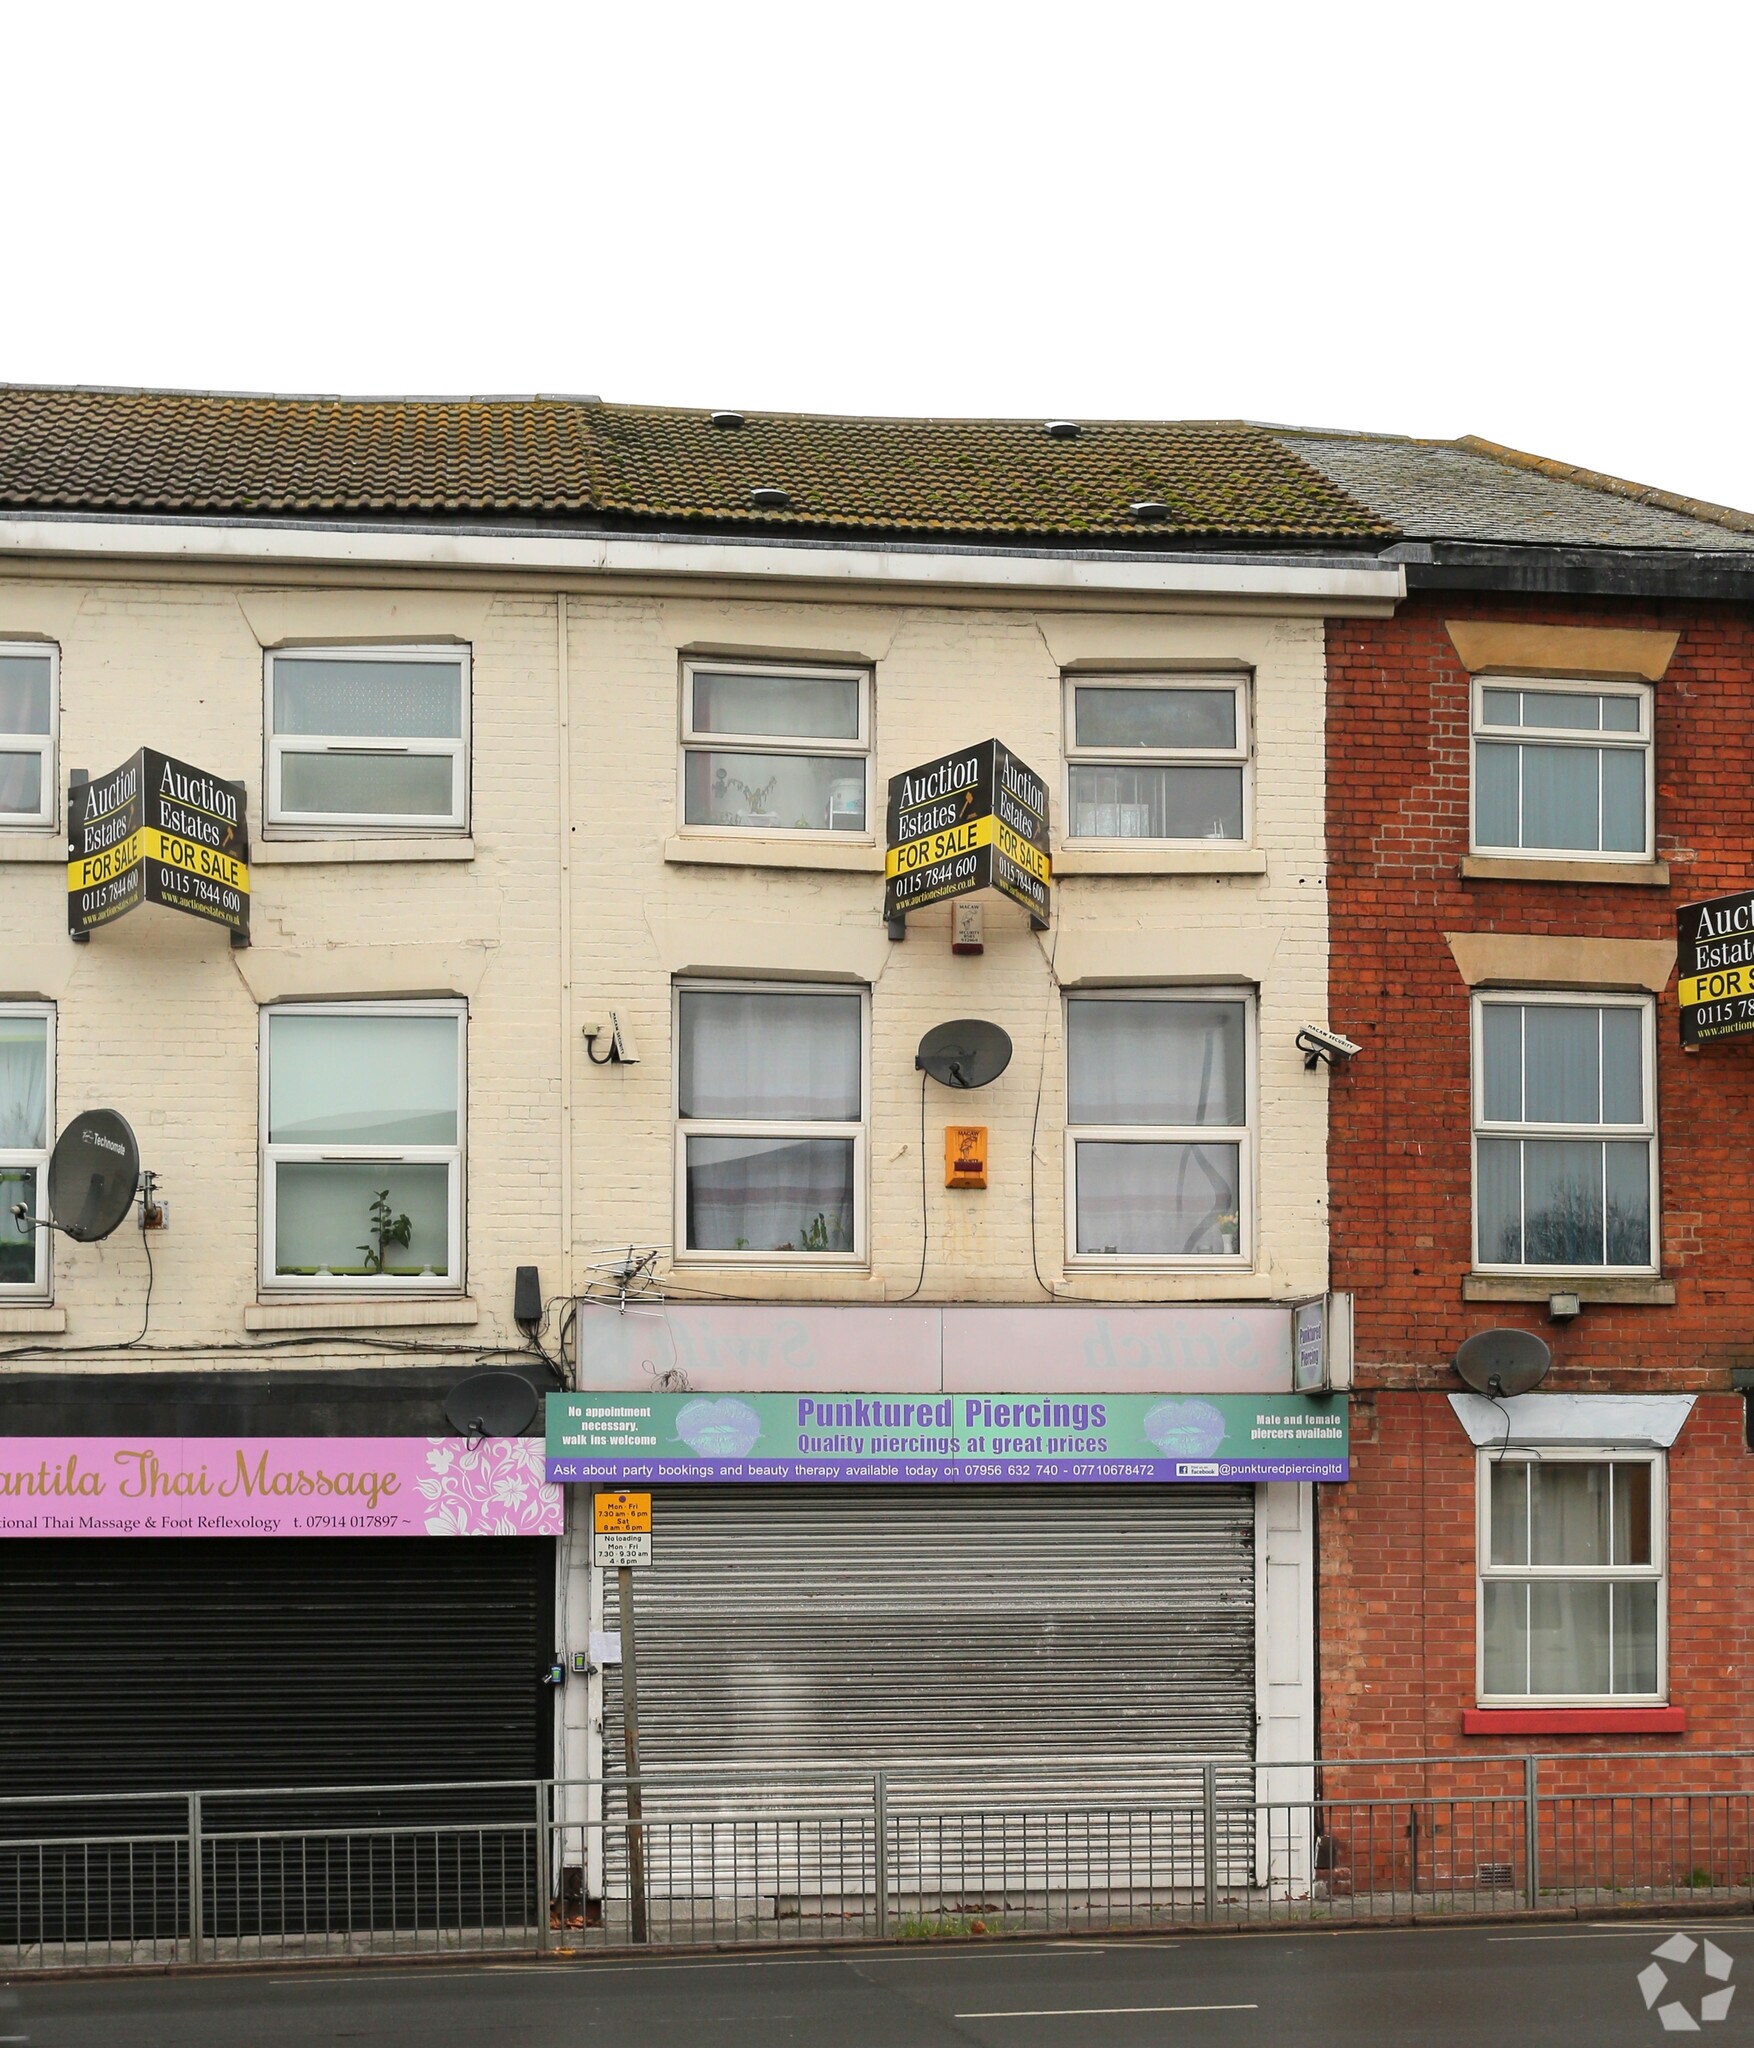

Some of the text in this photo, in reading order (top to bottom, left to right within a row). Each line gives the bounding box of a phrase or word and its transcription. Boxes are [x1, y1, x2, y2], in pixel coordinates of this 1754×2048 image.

[84, 768, 136, 820] Auction
[160, 761, 238, 822] Auction
[899, 757, 978, 809] Auction
[1002, 754, 1044, 816] Auction
[160, 800, 220, 846] Estates
[898, 803, 956, 841] Estates
[1000, 791, 1033, 839] Estates
[84, 815, 126, 854] Estates
[897, 824, 978, 872] FOR SALE
[1000, 825, 1042, 878] FOR SALE
[82, 836, 138, 885] FOR SALE
[160, 835, 239, 886] FOR SALE
[896, 855, 977, 897] 0115 7844 600
[82, 868, 138, 912] 0115 7844 600
[161, 868, 240, 912] 0115 7844 600
[896, 876, 976, 910] www.auctionestates.co.uk
[999, 856, 1044, 904] 0115 7844 600
[162, 892, 241, 926] www.auctionestates.co.uk
[1696, 938, 1754, 970] Estat
[1696, 972, 1742, 1000] FOR
[1697, 1002, 1732, 1026] 0115
[1308, 1024, 1353, 1049] MACAW SECURITY
[94, 1132, 126, 1156] Technomate
[568, 1406, 651, 1418] No appointment
[582, 1421, 638, 1432] necessary.
[798, 1398, 1107, 1430] Punktured Piercings
[1256, 1415, 1341, 1425] Male and female
[562, 1435, 657, 1445] walk ins welcome
[798, 1433, 1108, 1454] Quality piercings at great prices
[1251, 1428, 1342, 1440] piercers available
[114, 1450, 214, 1498] Thai
[218, 1450, 401, 1510] Massage
[554, 1464, 577, 1476] Ask
[582, 1464, 617, 1476] about
[623, 1466, 652, 1478] party
[659, 1464, 714, 1479] bookings
[720, 1464, 742, 1476] and
[748, 1464, 789, 1478] beauty
[795, 1464, 840, 1478] therapy
[846, 1465, 898, 1476] available
[905, 1465, 937, 1478] today
[944, 1467, 959, 1476] on
[965, 1465, 1002, 1476] 07956
[1008, 1465, 1030, 1476] 632
[1036, 1465, 1058, 1476] 740
[1073, 1465, 1154, 1476] 07710678472
[1219, 1464, 1342, 1476] @punkturedpiercingltd
[42, 1516, 74, 1529] Thai
[79, 1516, 141, 1532] Massage
[145, 1517, 156, 1528] &
[162, 1516, 193, 1528] Foot
[198, 1516, 281, 1532] Reflexology
[294, 1517, 302, 1528] t.
[306, 1516, 346, 1528] 07914
[350, 1516, 398, 1528] 017897
